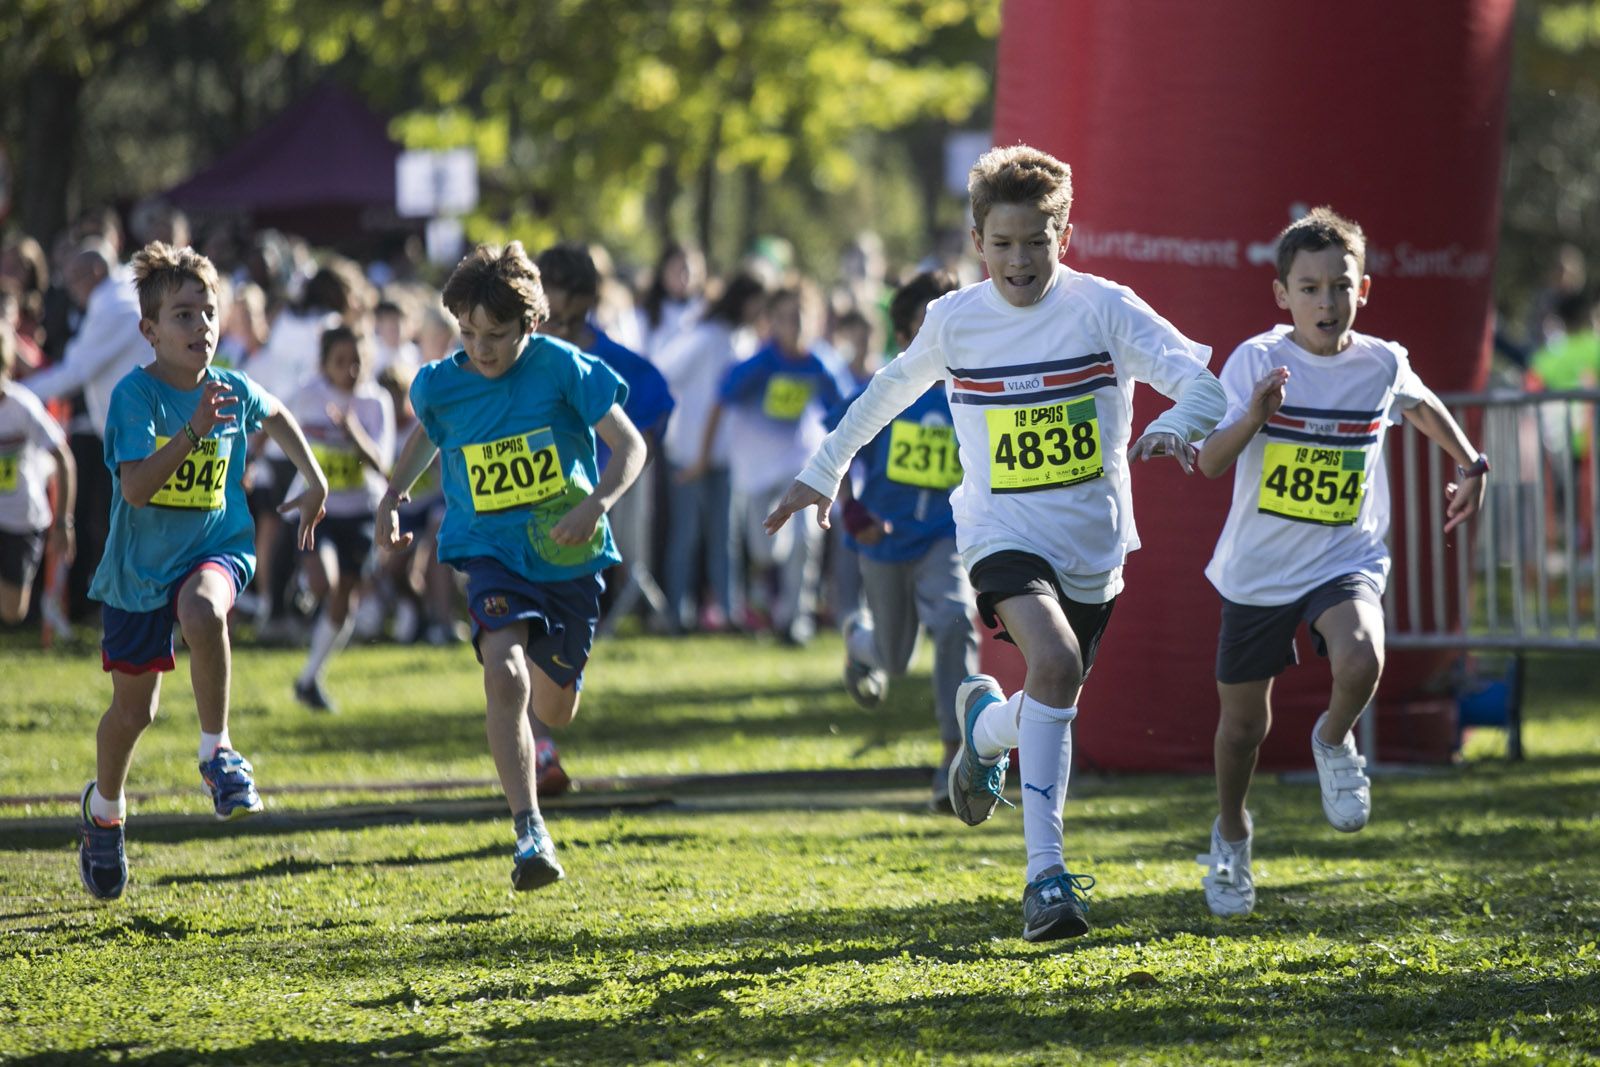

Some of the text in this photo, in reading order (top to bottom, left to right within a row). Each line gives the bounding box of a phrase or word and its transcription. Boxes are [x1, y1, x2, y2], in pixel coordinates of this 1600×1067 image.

[1008, 379, 1040, 391] VIARÓ
[1014, 410, 1026, 427] 19
[482, 445, 493, 460] 19
[995, 421, 1096, 470] 4838
[1295, 448, 1309, 463] 19
[162, 459, 226, 492] 942
[471, 448, 558, 496] 2202
[1265, 464, 1360, 506] 4854
